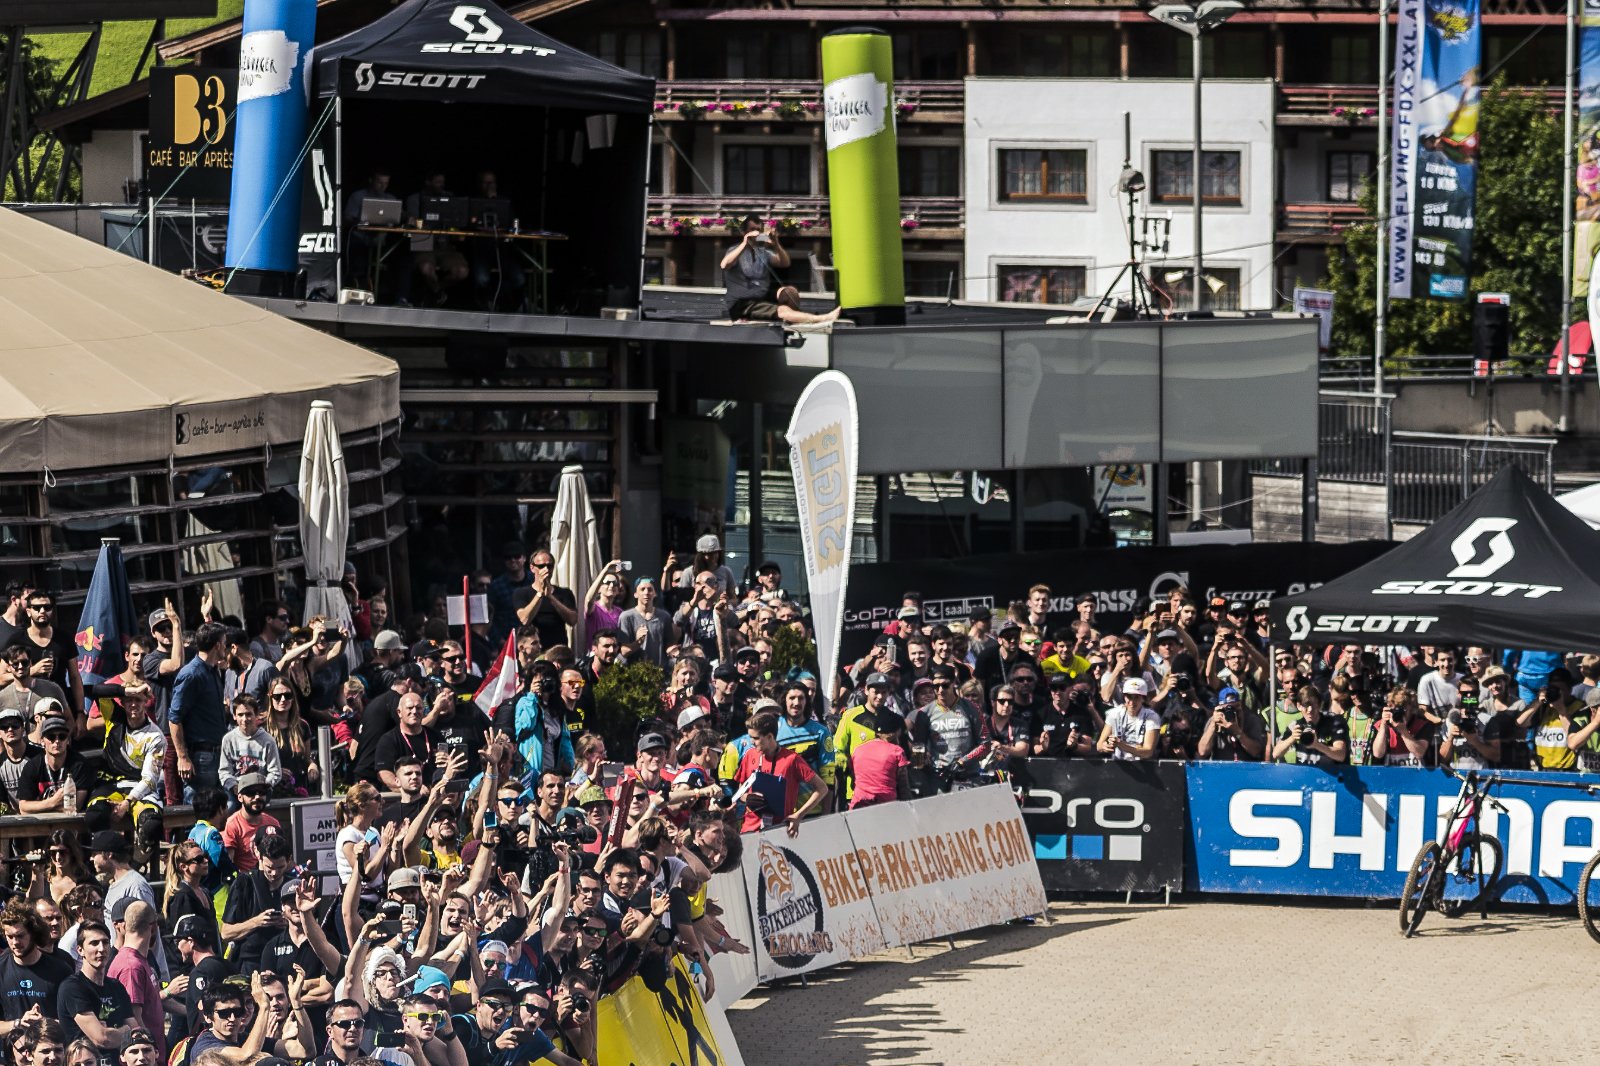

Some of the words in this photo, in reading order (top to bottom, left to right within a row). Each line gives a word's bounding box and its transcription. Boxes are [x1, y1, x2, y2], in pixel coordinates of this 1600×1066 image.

[420, 42, 557, 57] SCOTT
[378, 71, 487, 89] SCOTT
[174, 74, 227, 144] B3
[150, 146, 172, 167] CAFÉ
[179, 150, 198, 168] BAR
[298, 232, 337, 253] SCO
[1220, 589, 1277, 602] SCOTT
[1371, 580, 1564, 599] SCOTT
[1312, 615, 1439, 634] SCOTT
[1022, 789, 1145, 830] Pro
[316, 819, 337, 830] ANT
[309, 832, 337, 843] DOPI
